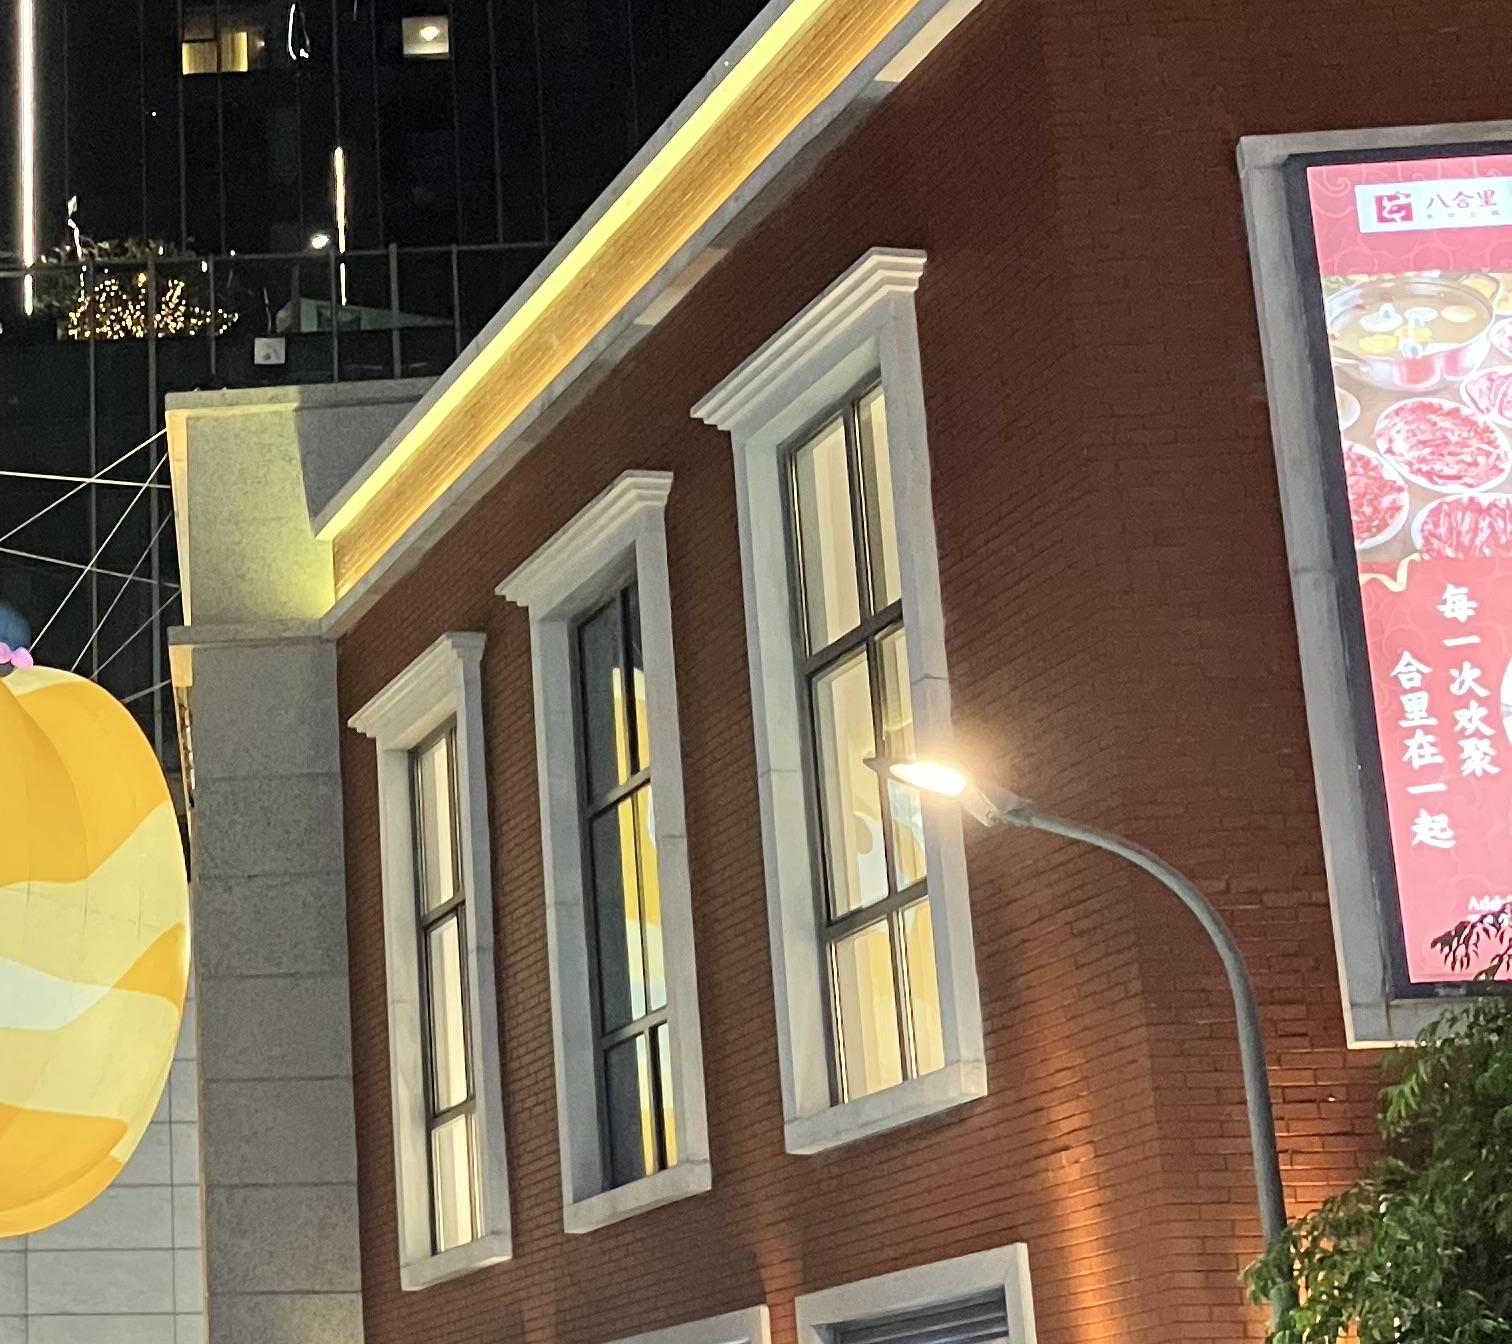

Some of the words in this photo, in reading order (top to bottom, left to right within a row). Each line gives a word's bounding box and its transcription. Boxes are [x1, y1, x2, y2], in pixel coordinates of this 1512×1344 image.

[1425, 189, 1498, 210] 八合里
[1390, 650, 1457, 849] 合里在一起
[1436, 583, 1501, 778] 每一次欢聚
